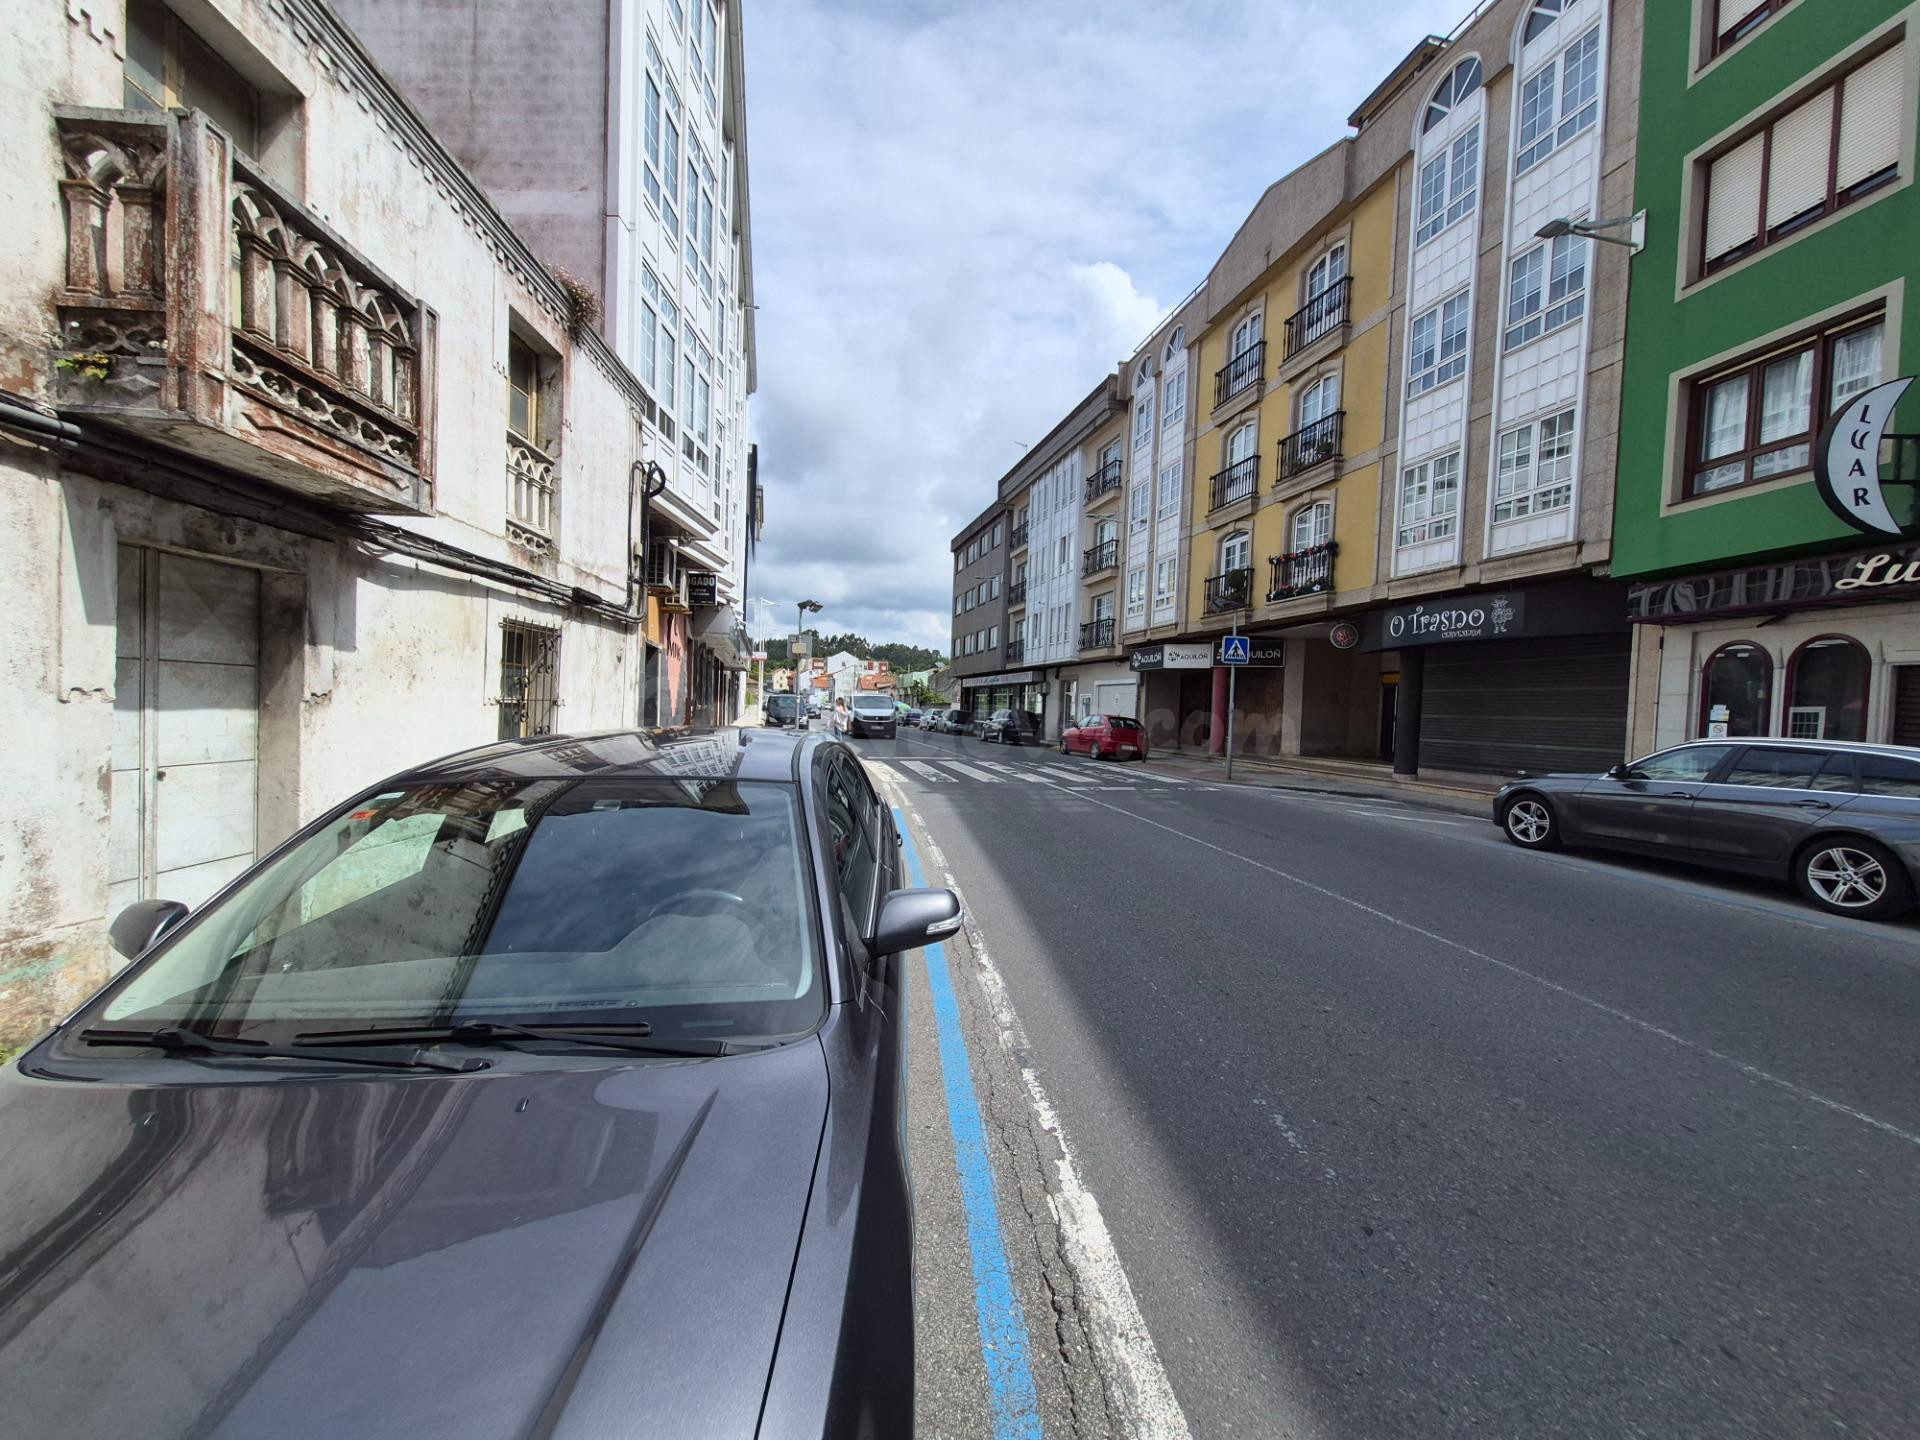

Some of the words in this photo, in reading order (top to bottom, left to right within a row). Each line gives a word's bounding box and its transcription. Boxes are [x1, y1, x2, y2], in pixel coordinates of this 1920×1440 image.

[688, 576, 715, 587] GADO
[1390, 615, 1405, 637] O
[1408, 605, 1485, 634] Trasno
